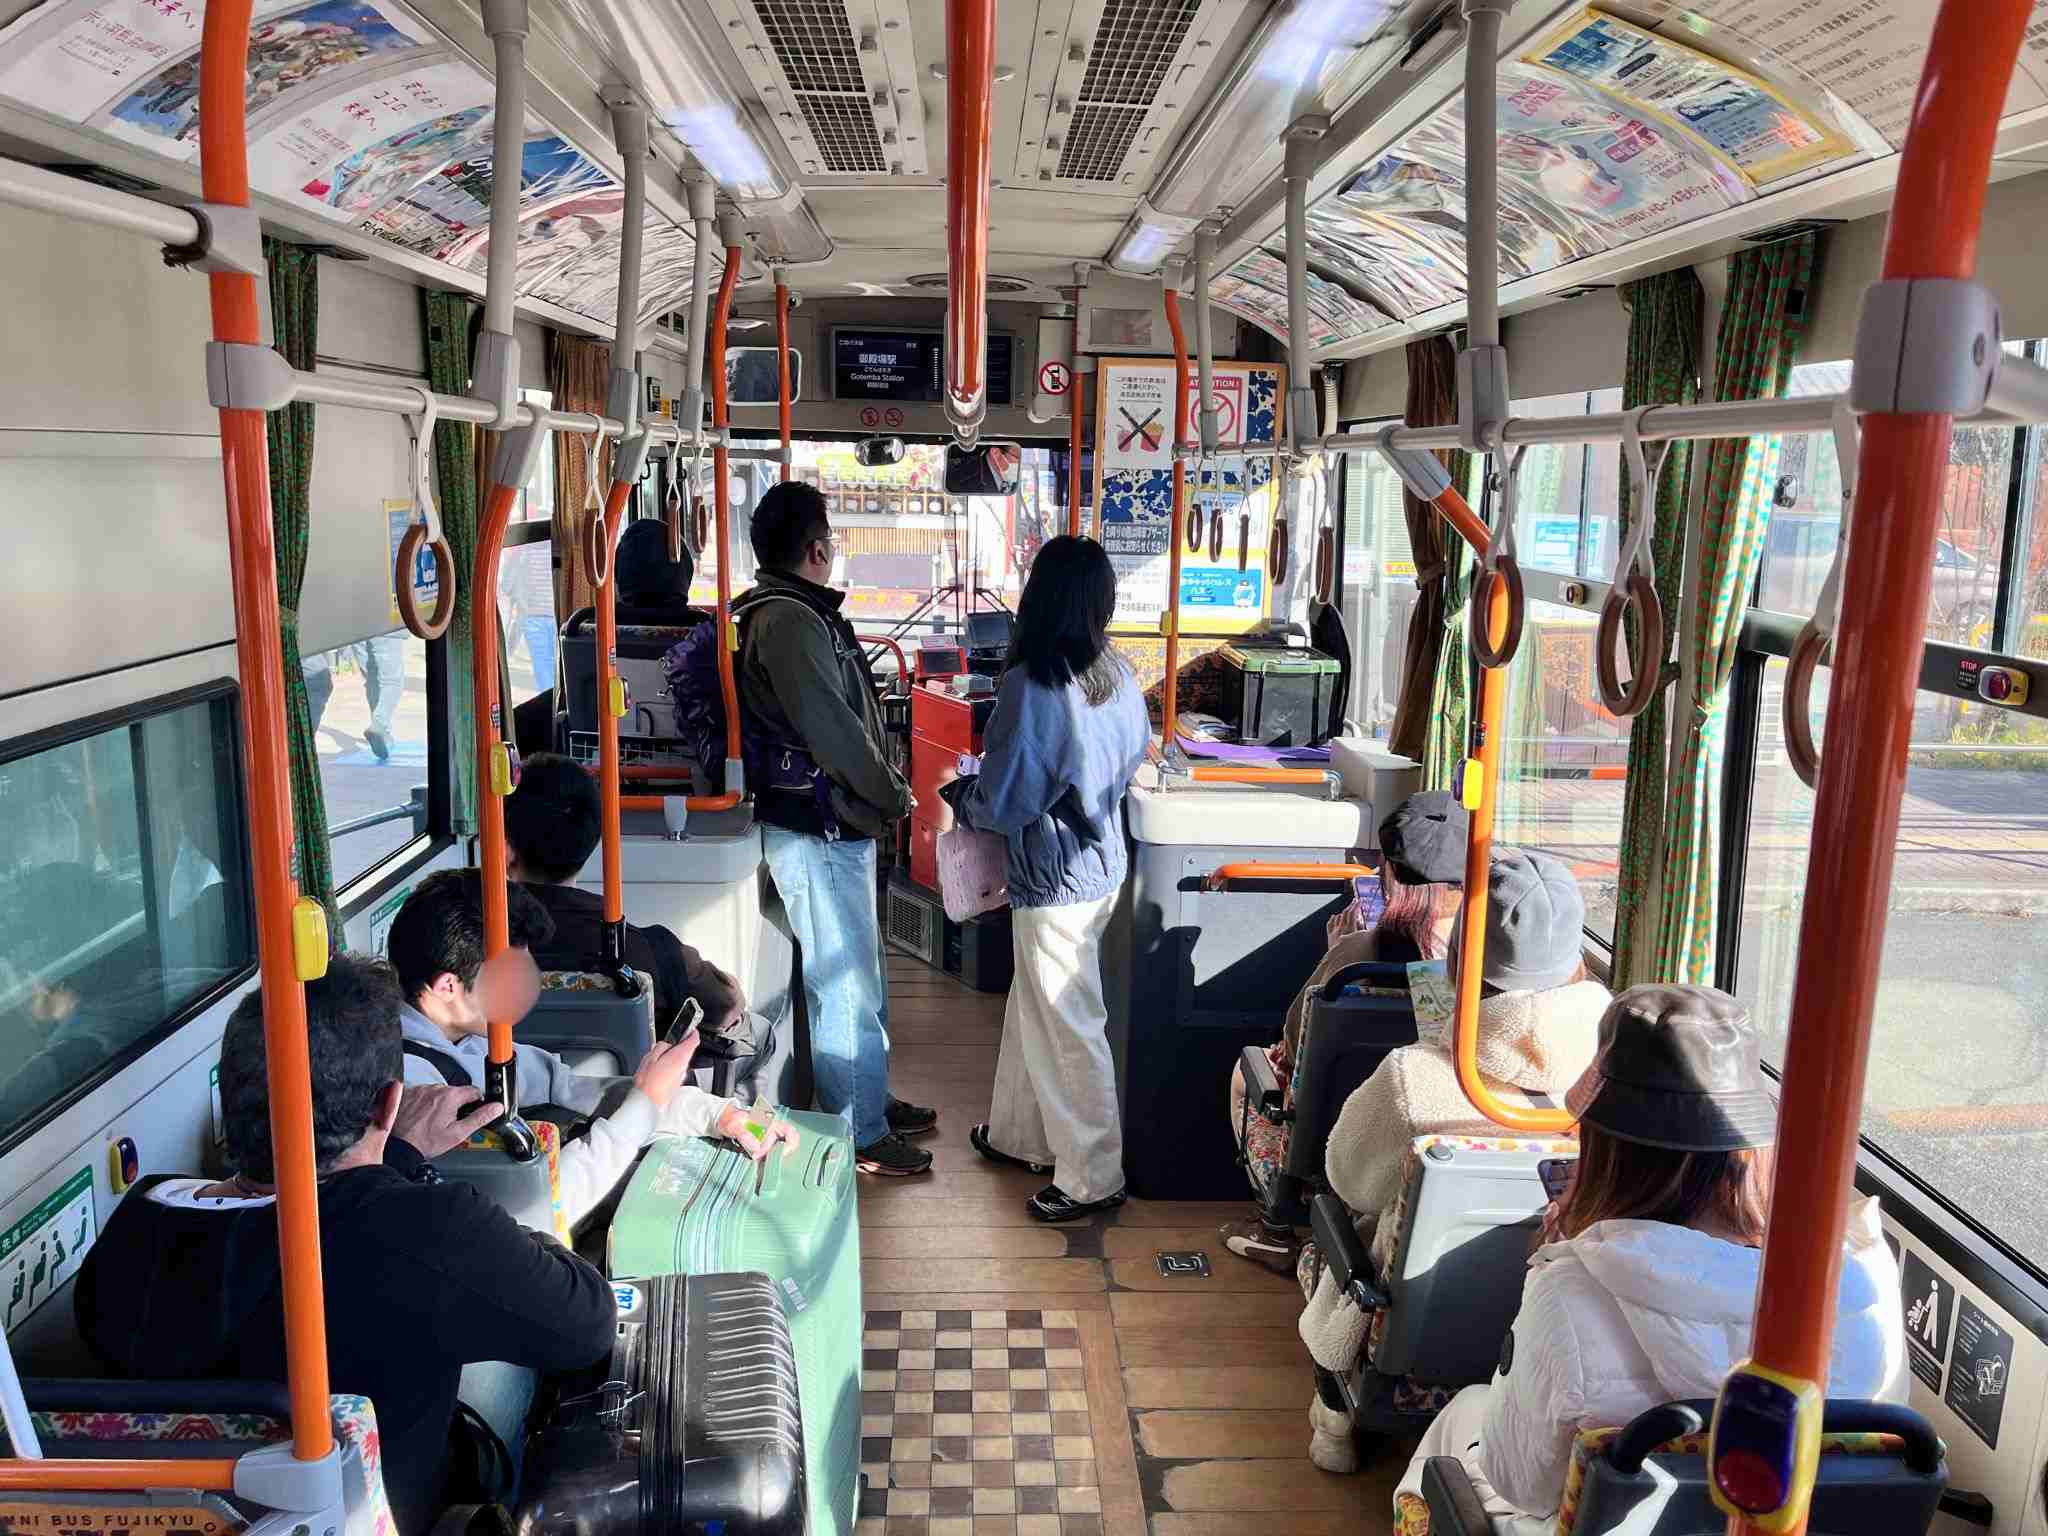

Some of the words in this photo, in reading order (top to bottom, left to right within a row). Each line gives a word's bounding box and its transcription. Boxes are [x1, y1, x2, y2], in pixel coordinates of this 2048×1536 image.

[858, 353, 897, 365] 御殿場駅
[850, 373, 881, 381] Gotemba
[1960, 660, 1977, 670] STOP
[615, 1288, 634, 1310] 787
[0, 1515, 39, 1526] MNI
[51, 1514, 93, 1526] BUS
[104, 1514, 193, 1526] FUJIKYU
